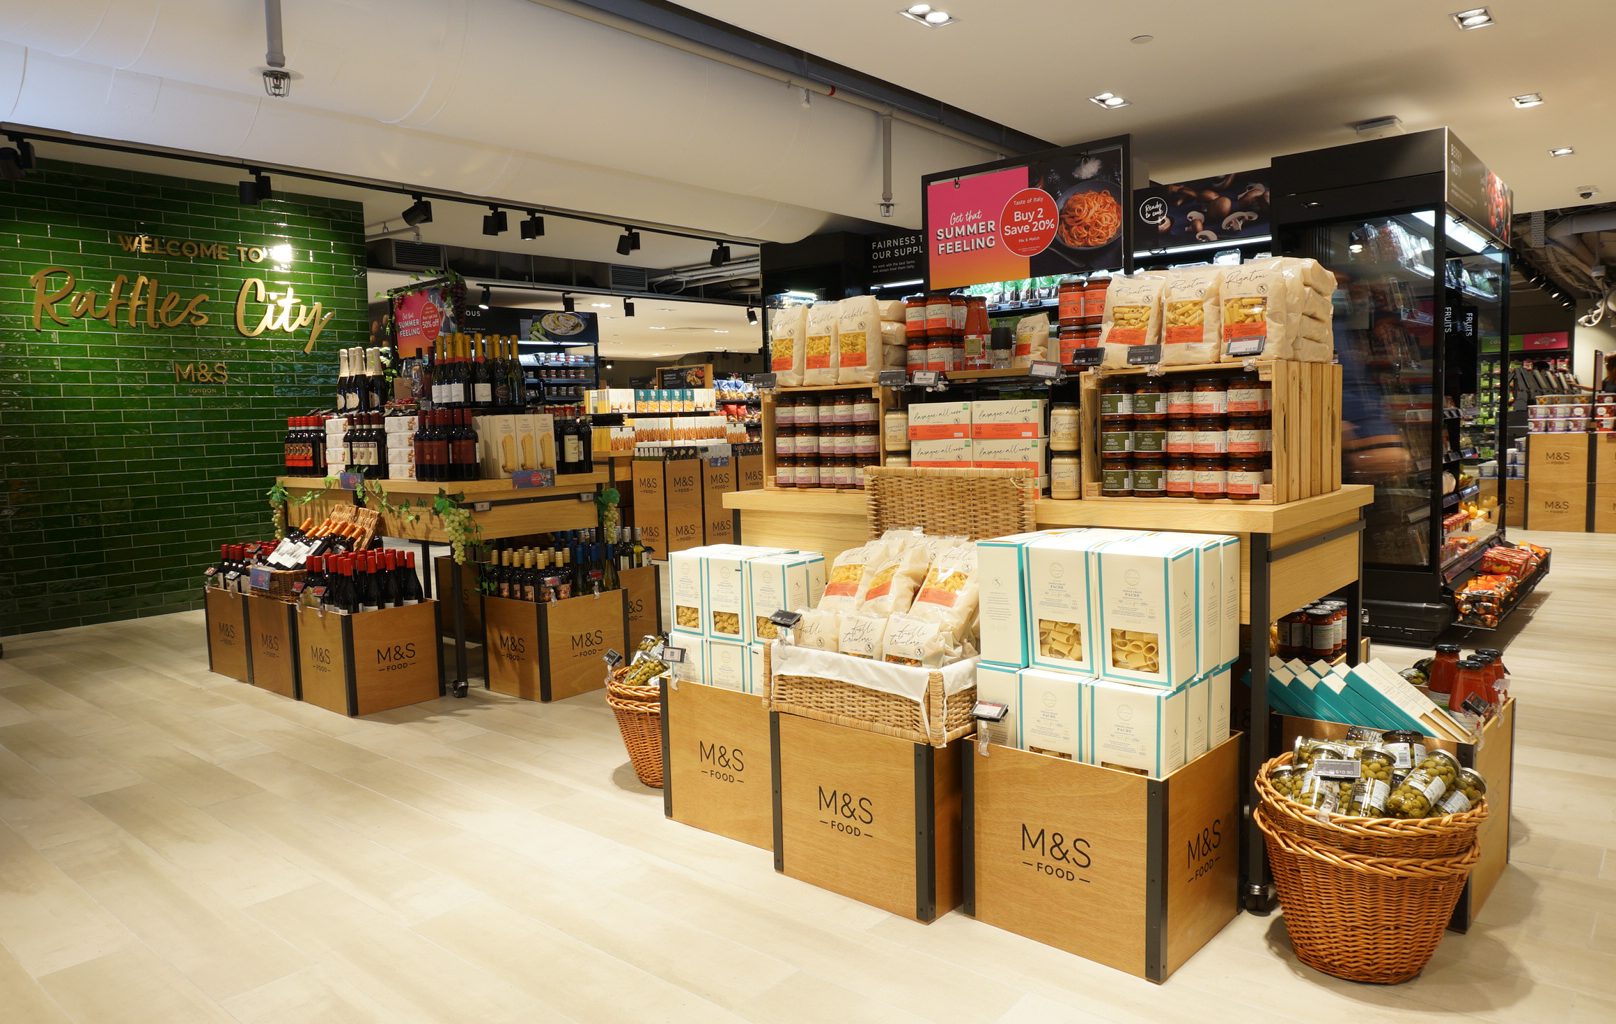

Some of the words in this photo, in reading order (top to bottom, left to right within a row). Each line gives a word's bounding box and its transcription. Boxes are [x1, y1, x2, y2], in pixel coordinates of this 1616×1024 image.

[950, 211, 964, 226] Get
[965, 209, 983, 222] that
[1014, 211, 1035, 223] Buy
[1037, 207, 1044, 218] 2
[936, 220, 996, 240] SUMMER
[1004, 224, 1030, 236] Save
[1032, 218, 1055, 232] 20%
[118, 233, 230, 262] WELCOME
[236, 246, 265, 264] TO
[872, 235, 916, 250] FAIRNESS
[937, 236, 996, 255] FEELING
[872, 250, 891, 260] OUR
[894, 246, 923, 257] SUPPL
[30, 266, 210, 332] Raffles
[236, 277, 335, 355] City
[1444, 306, 1452, 333] FRUITS
[1465, 312, 1473, 337] FRUITS
[175, 362, 228, 383] M&S
[1545, 452, 1571, 461] M&S
[640, 478, 657, 488] M&S
[673, 476, 694, 487] M&S
[710, 473, 730, 484] M&S
[745, 470, 763, 481] M&S
[1544, 501, 1570, 510] M&S
[641, 526, 659, 537] M&S
[675, 524, 696, 536] M&S
[712, 520, 731, 531] M&S
[219, 622, 235, 639] M&S
[261, 633, 280, 651] M&S
[500, 634, 526, 654] M&S
[571, 630, 604, 651] M&S
[311, 645, 331, 665] M&S
[377, 642, 416, 664] M&S
[579, 649, 599, 658] FOOD
[386, 663, 409, 672] FOOD
[699, 740, 745, 772] M&S
[710, 769, 735, 783] FOOD
[818, 785, 873, 825] M&S
[831, 820, 861, 837] FOOD
[1021, 823, 1092, 869] M&S
[1187, 819, 1222, 869] M&S
[1036, 862, 1075, 882] FOOD
[1194, 859, 1214, 881] FOOD
